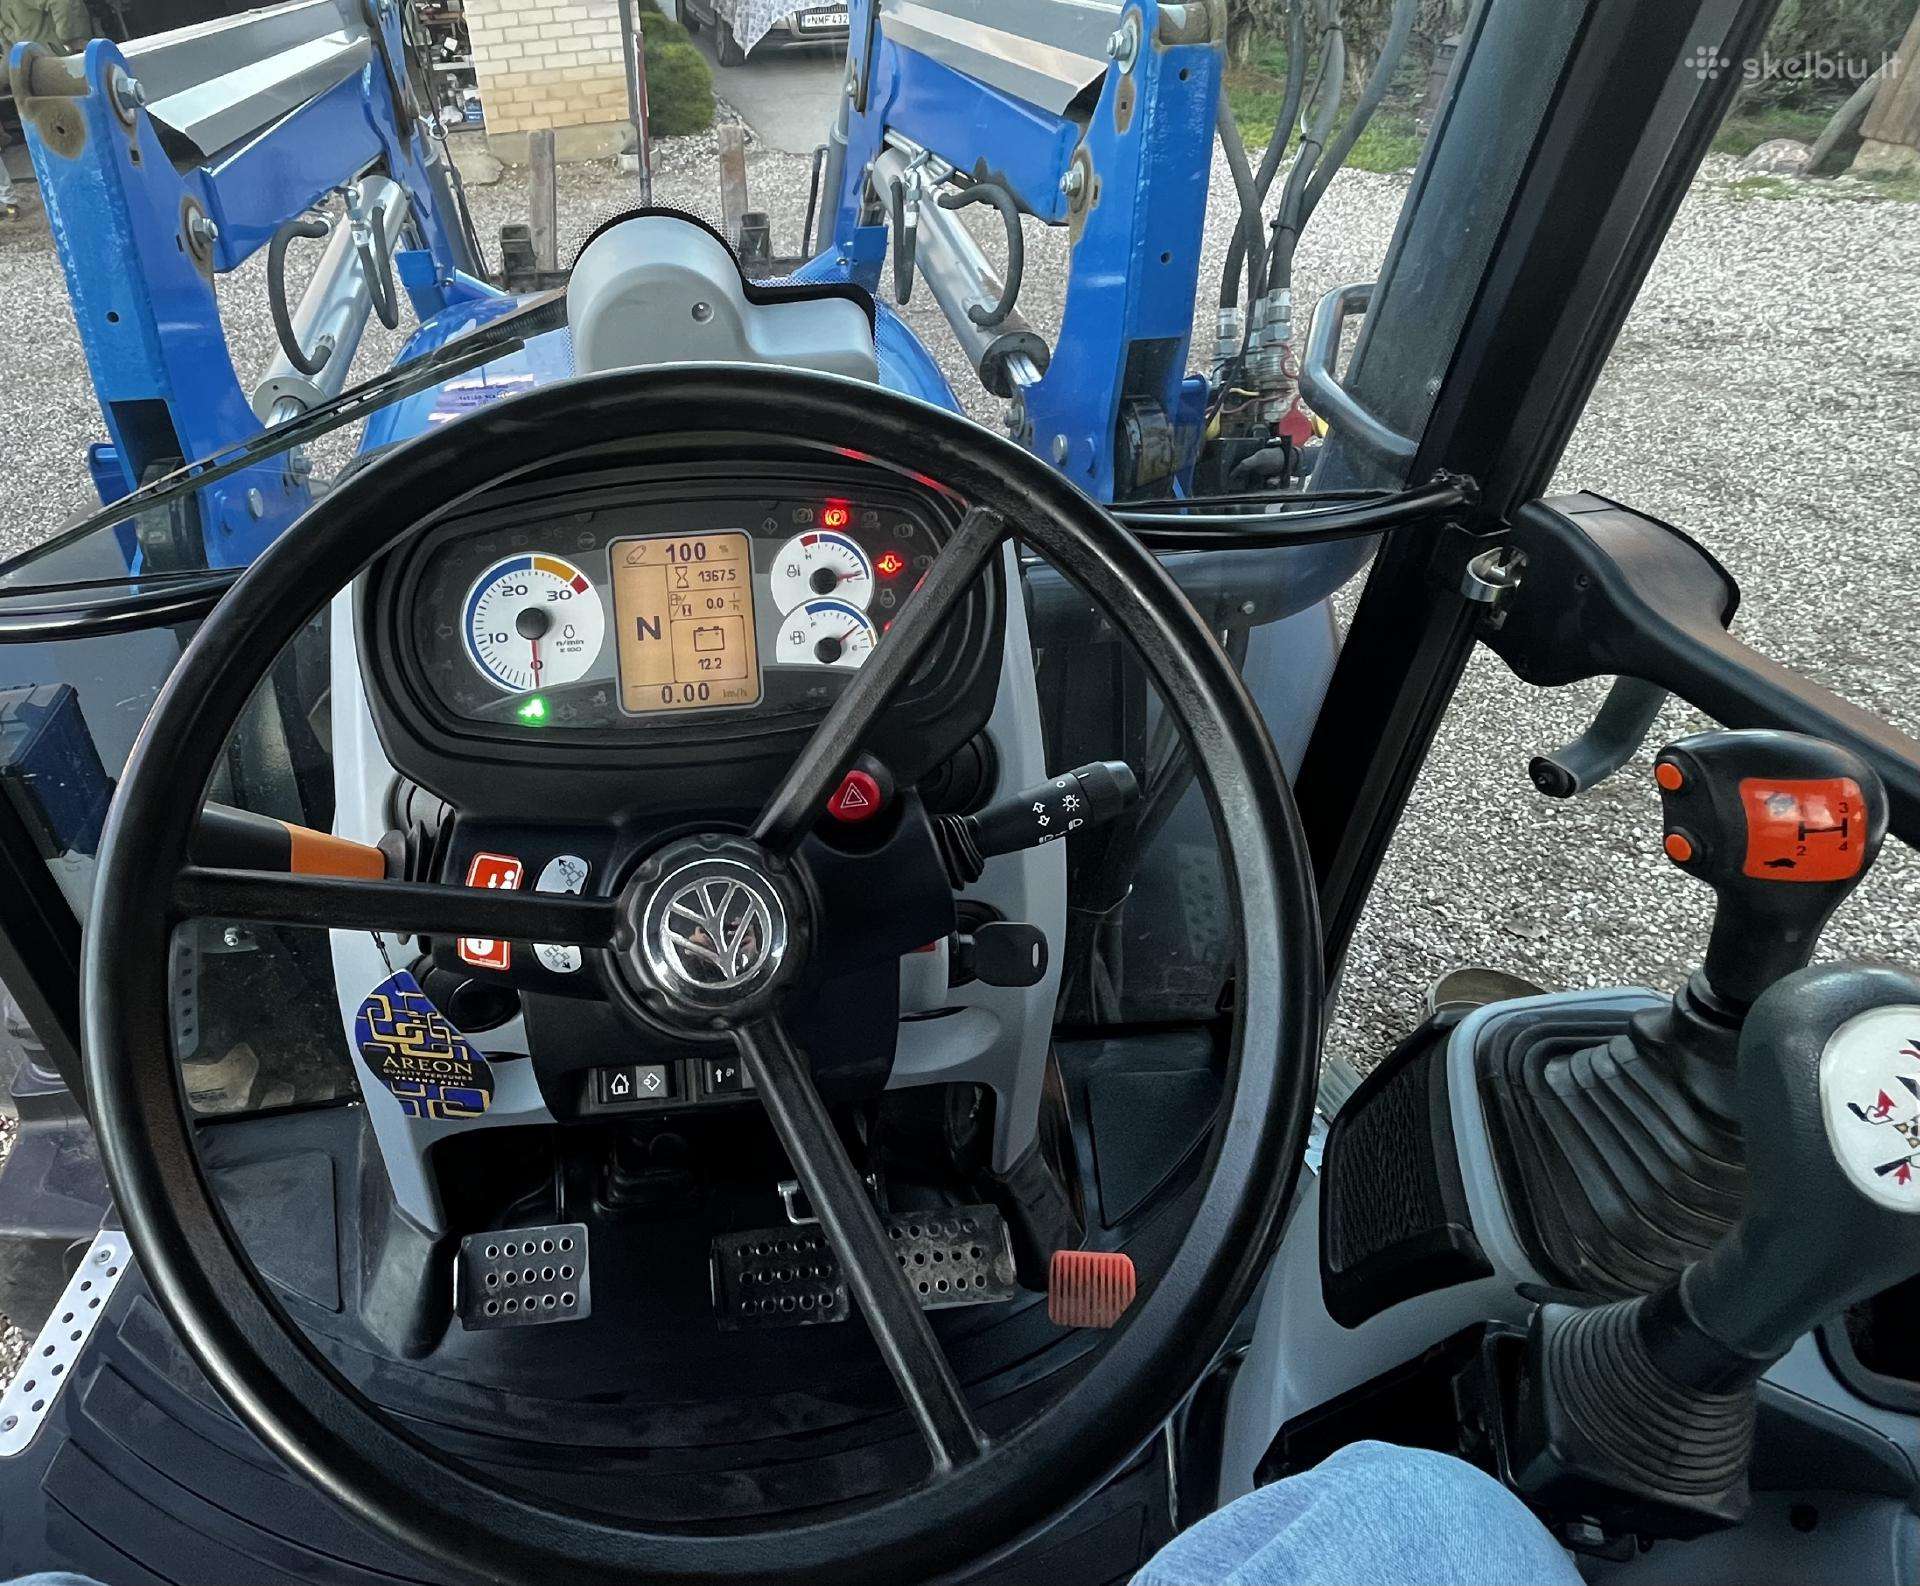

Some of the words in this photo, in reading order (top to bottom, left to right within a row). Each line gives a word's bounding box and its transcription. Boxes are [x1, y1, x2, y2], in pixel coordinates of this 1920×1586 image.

[666, 542, 706, 563] 100
[698, 568, 736, 583] 1367.5
[502, 585, 528, 597] 20
[546, 589, 572, 602] 30
[706, 597, 724, 610] 0.0
[636, 615, 662, 642] N
[488, 632, 509, 644] 10
[698, 657, 722, 670] 12.2
[661, 682, 710, 704] 0.00
[723, 688, 748, 699] km/h
[1838, 802, 1848, 813] 3
[1796, 846, 1806, 856] 2
[1838, 841, 1848, 851] 4
[383, 1056, 472, 1074] AREON
